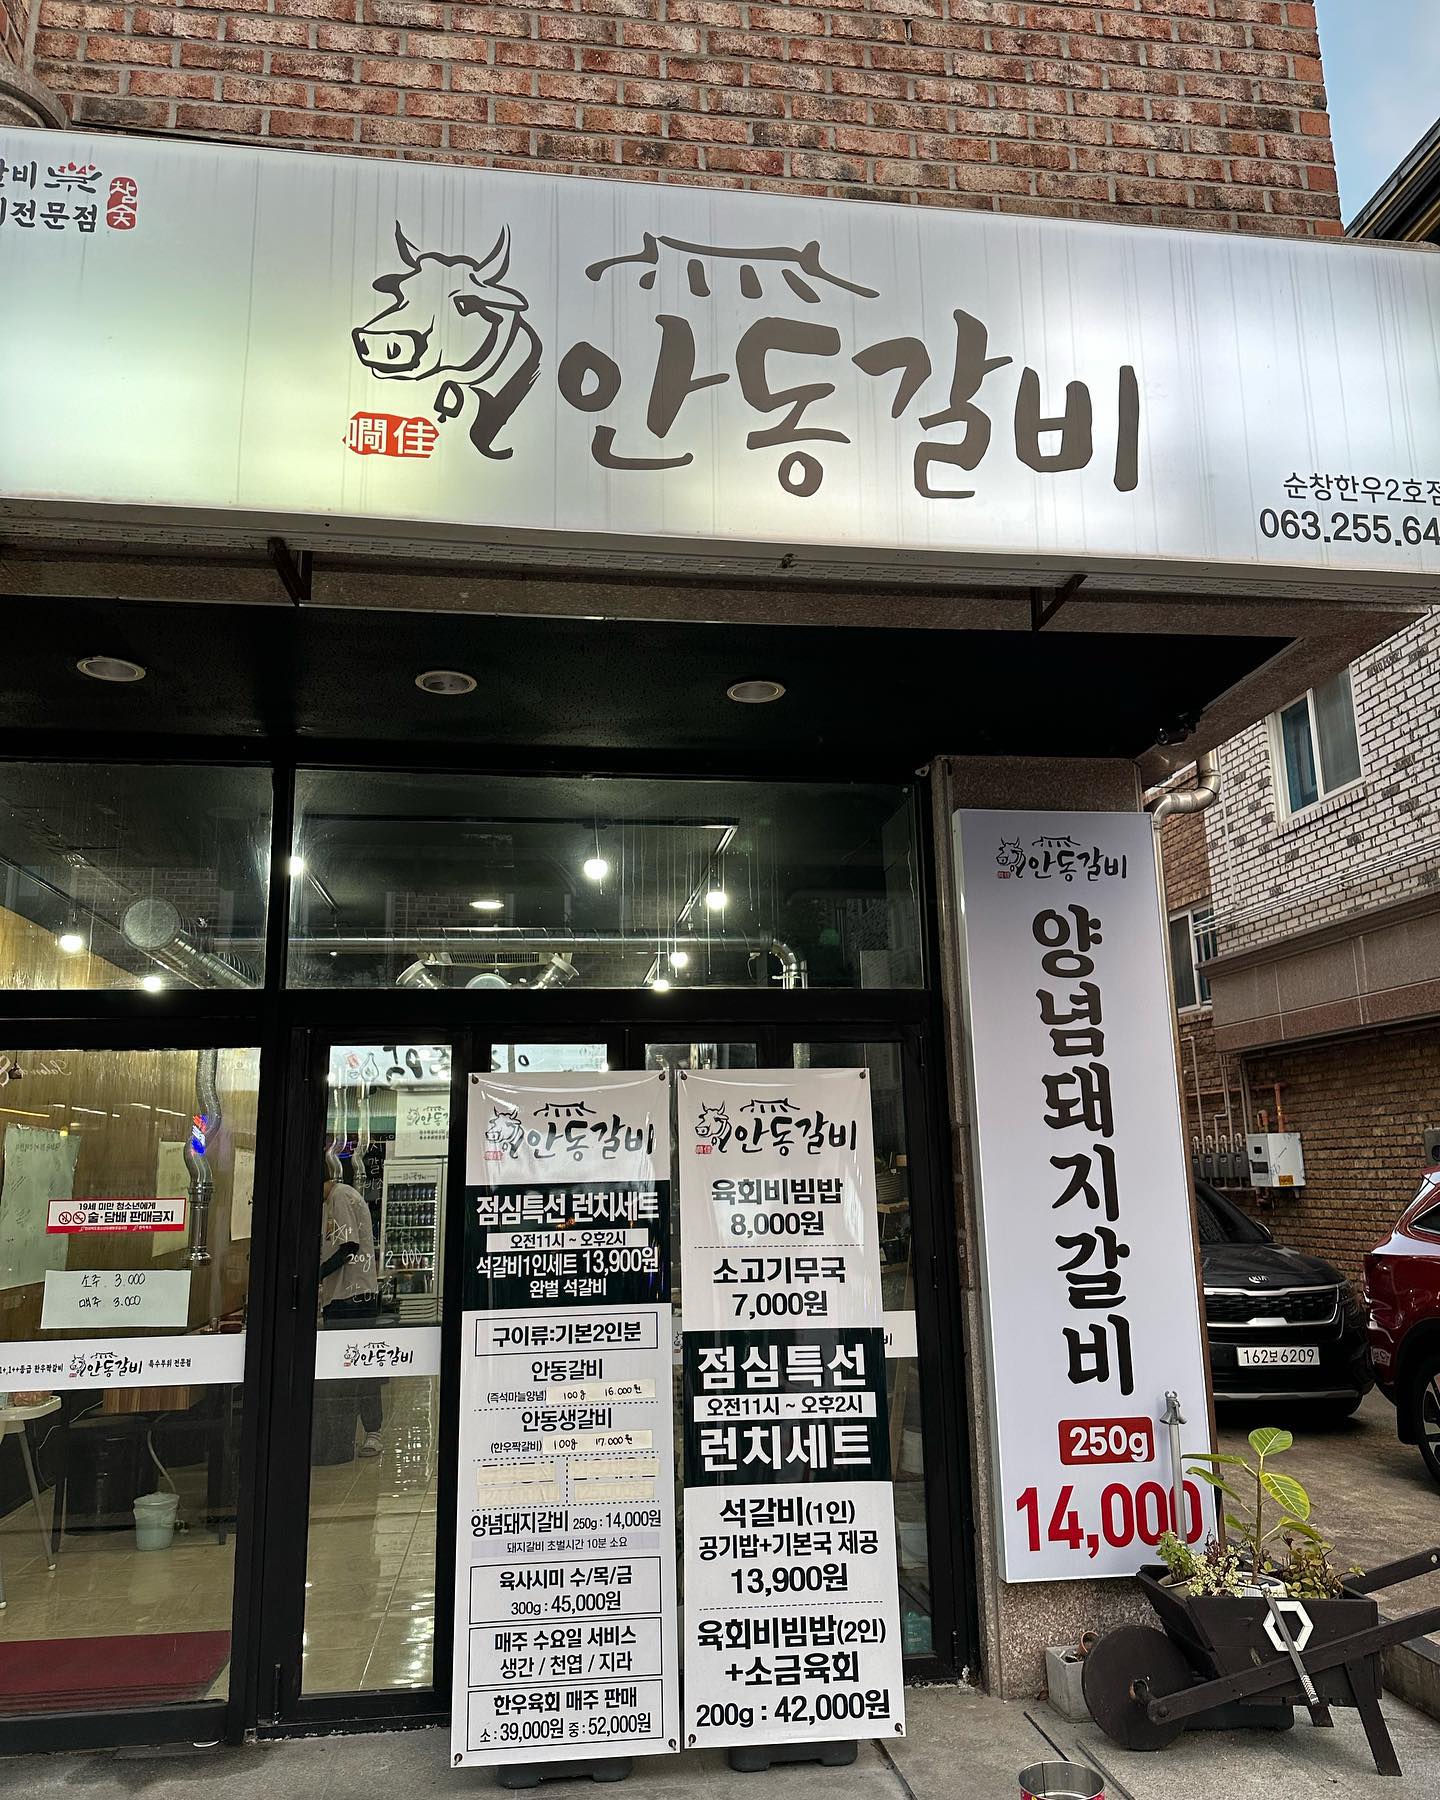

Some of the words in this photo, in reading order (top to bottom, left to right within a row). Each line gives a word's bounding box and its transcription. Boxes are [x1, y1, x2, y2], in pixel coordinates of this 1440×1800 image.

[557, 309, 1140, 498] 안동갈비
[1028, 846, 1127, 882] 안동갈비
[527, 1113, 654, 1162] 안동갈비
[734, 1111, 857, 1157] 안동갈비
[1032, 904, 1134, 1396] 양념돼지갈비
[711, 1178, 843, 1205] 육회비빔밥
[116, 1202, 156, 1210] 청소년에게
[130, 1211, 174, 1222] 판매금지
[476, 1193, 566, 1226] 점심특선
[572, 1191, 659, 1223] 런치세트
[731, 1211, 824, 1238] 8,000원
[510, 1232, 565, 1249] 오전11시
[581, 1231, 626, 1246] 오후2시
[476, 1254, 577, 1279] 석갈비1인세트
[583, 1246, 659, 1275] 13,900원
[713, 1257, 846, 1284] 소고기무국
[529, 1281, 558, 1299] 완벌
[563, 1278, 607, 1297] 석갈비
[733, 1290, 827, 1319] 7,000원
[492, 1321, 642, 1348] 구이류:기본2인분
[88, 1357, 142, 1377] 안동갈비
[361, 1346, 413, 1367] 안동갈비
[531, 1358, 603, 1382] 안동갈비
[698, 1343, 866, 1390] 점심특선
[1244, 1349, 1314, 1364] 162보6209
[707, 1397, 779, 1416] 오전11시
[801, 1395, 862, 1413] 오후2시
[521, 1408, 612, 1432] 안동생갈비
[700, 1424, 871, 1472] 런치세트
[1070, 1424, 1149, 1462] 250g
[471, 1511, 569, 1538] 양념돼지갈비
[605, 1510, 661, 1530] 14,000원
[720, 1497, 855, 1529] 석갈비(1인)
[1015, 1479, 1203, 1558] 14,000
[507, 1540, 544, 1553] 돼지갈비
[547, 1538, 584, 1551] 초벌시간
[587, 1538, 606, 1549] 10분
[610, 1536, 627, 1547] 소요
[838, 1530, 878, 1554] 제공
[499, 1568, 564, 1590] 육사시미
[570, 1565, 633, 1587] 수/목/금
[731, 1563, 848, 1597] 13,900원
[551, 1591, 621, 1615] 45,000원
[494, 1632, 528, 1652] 매주
[533, 1629, 582, 1650] 수요일
[587, 1626, 636, 1646] 서비스
[698, 1615, 886, 1651] 육회비빔밥(2인)
[500, 1657, 534, 1679] 생간
[550, 1654, 582, 1675] 천엽
[599, 1651, 633, 1673] 지라
[725, 1651, 859, 1686] +소금육회
[493, 1692, 560, 1716] 한우육회
[566, 1690, 599, 1711] 매주
[604, 1687, 637, 1708] 판매
[696, 1703, 754, 1728] 200g
[774, 1689, 890, 1725] 42,000원
[500, 1718, 564, 1742] 39,000원
[588, 1712, 651, 1737] 52,000원
